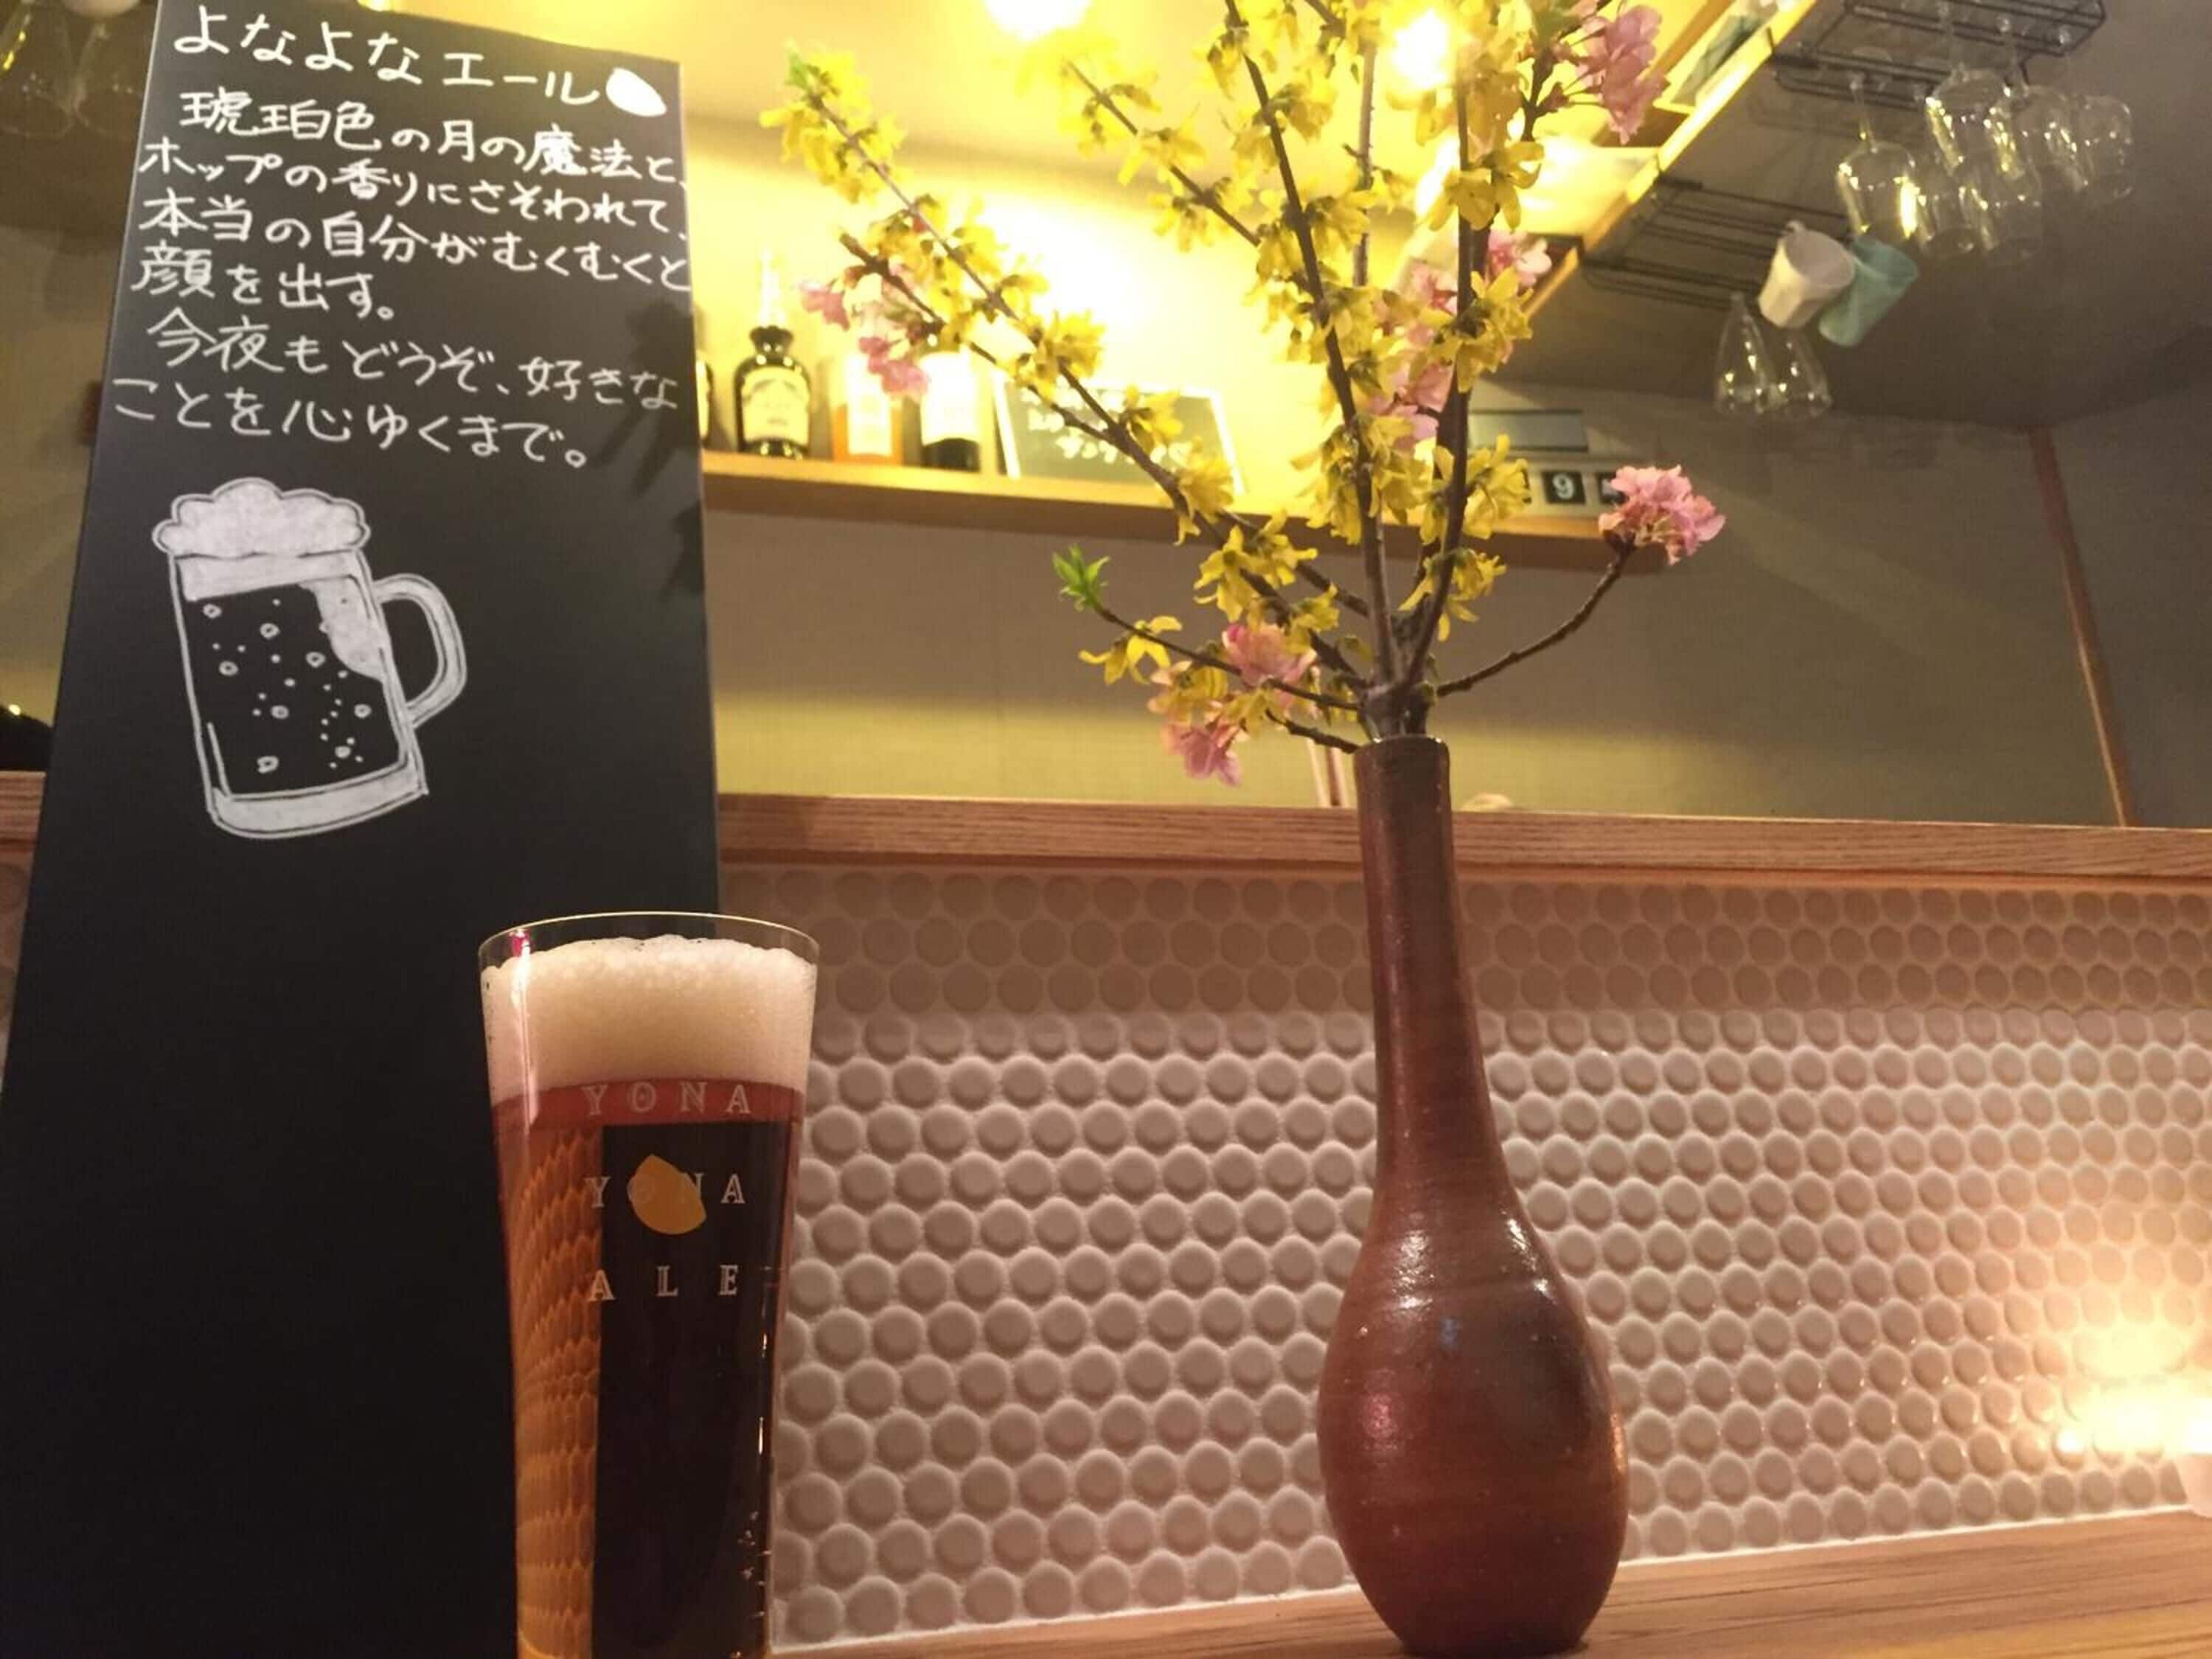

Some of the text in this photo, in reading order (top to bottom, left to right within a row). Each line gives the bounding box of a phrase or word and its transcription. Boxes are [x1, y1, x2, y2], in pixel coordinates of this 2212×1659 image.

[139, 187, 692, 291] 本当の自分がむくむくと
[131, 244, 394, 320] 顔を出す。
[581, 1081, 751, 1116] YONA
[589, 1264, 739, 1302] ALE
